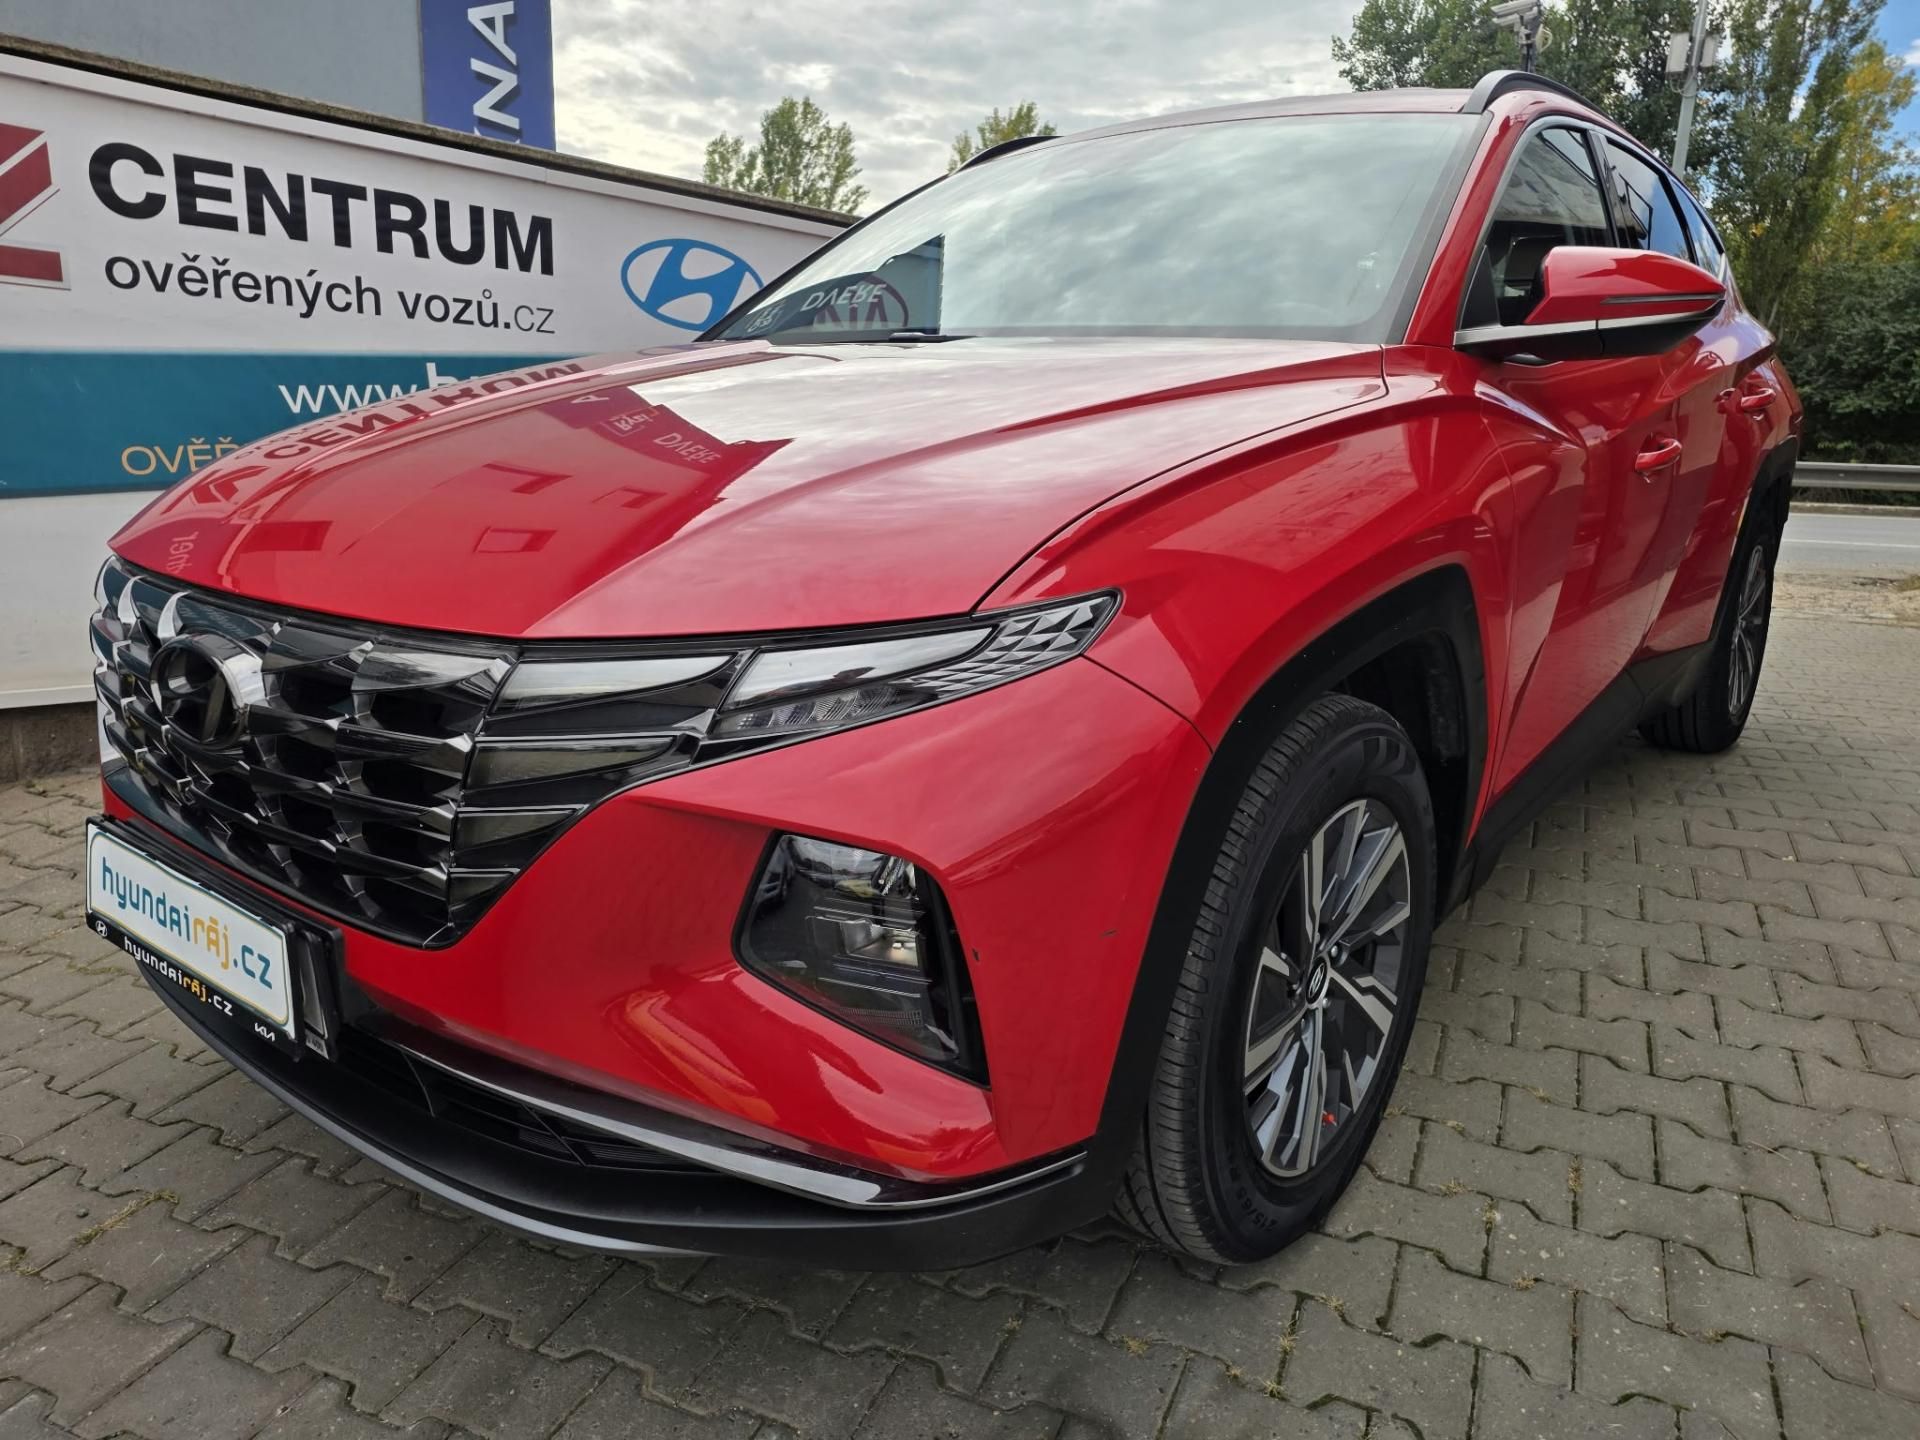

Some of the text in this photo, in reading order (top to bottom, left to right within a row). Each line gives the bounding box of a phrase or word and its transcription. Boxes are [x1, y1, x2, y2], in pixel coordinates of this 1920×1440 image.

[466, 0, 521, 144] NA
[89, 142, 555, 276] CENTRUM
[105, 253, 555, 334] ověřených vozů.cz
